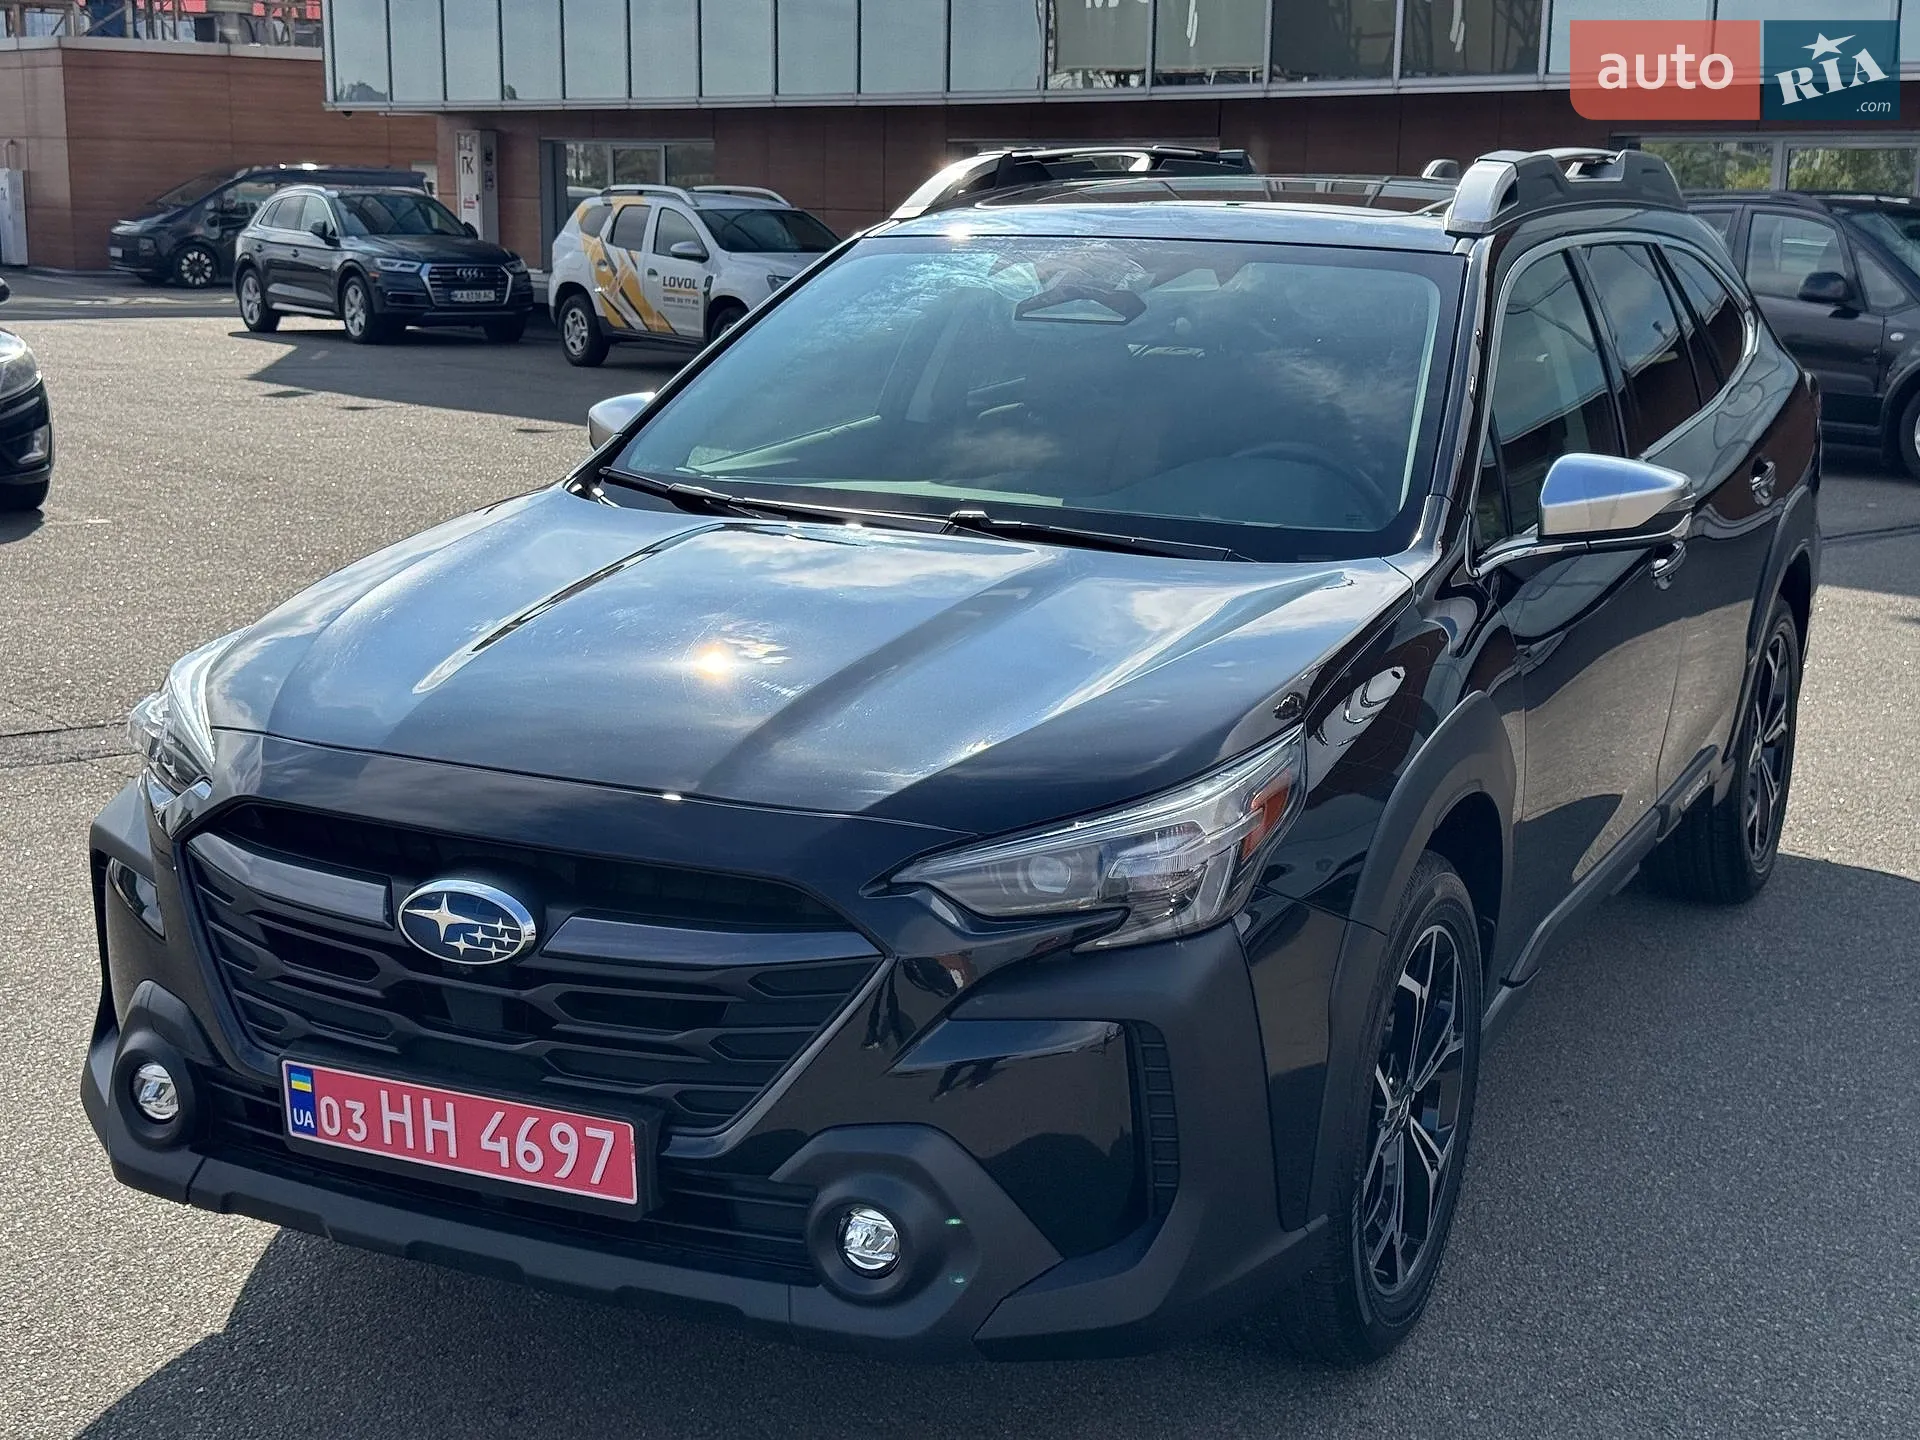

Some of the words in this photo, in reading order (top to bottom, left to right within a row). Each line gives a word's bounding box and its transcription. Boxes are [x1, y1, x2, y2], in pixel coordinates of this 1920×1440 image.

[662, 276, 698, 290] LOVOL
[292, 1107, 315, 1129] UA
[320, 1096, 368, 1143] 03
[380, 1090, 458, 1159] HH
[480, 1111, 615, 1185] 4697
